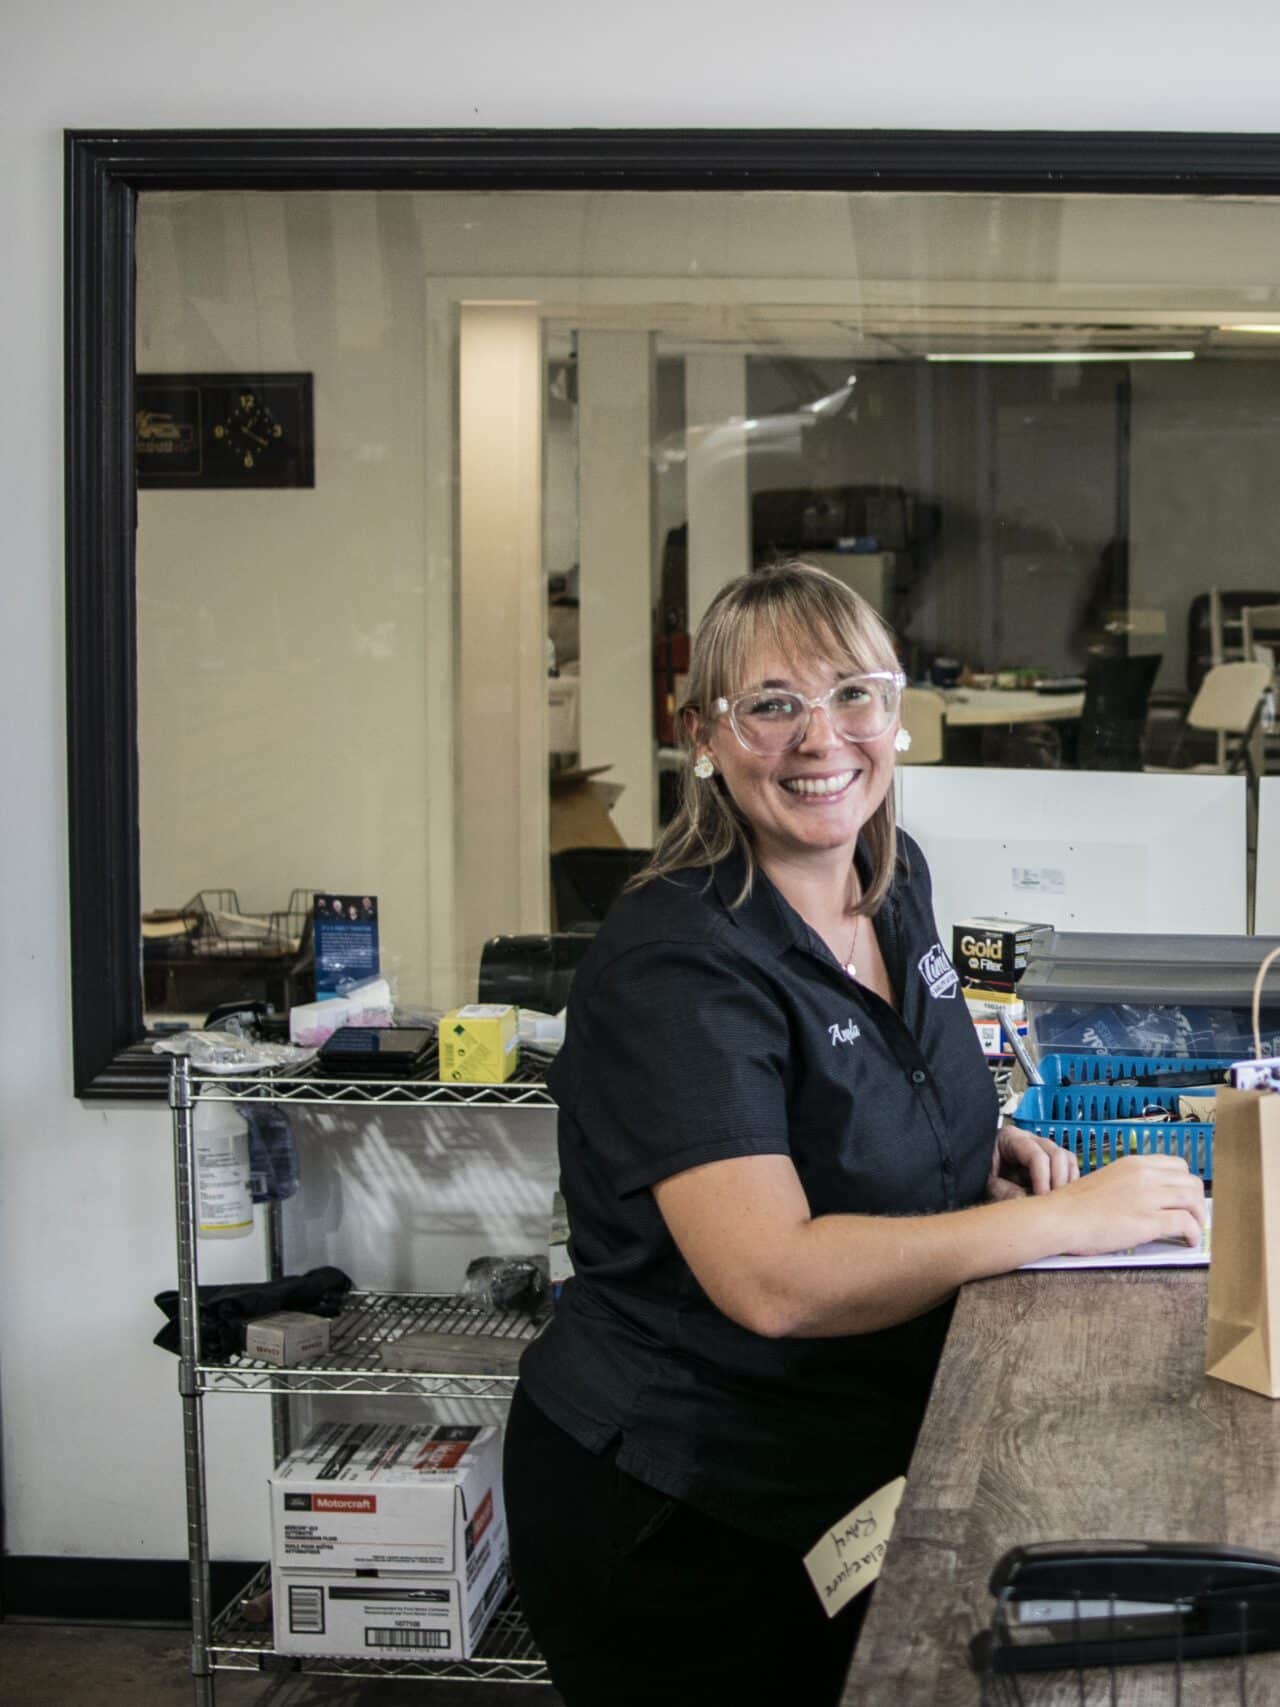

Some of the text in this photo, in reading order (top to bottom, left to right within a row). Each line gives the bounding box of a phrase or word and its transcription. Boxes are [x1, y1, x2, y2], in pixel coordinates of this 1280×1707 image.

[240, 393, 255, 408] 12
[272, 424, 283, 438] 3
[960, 935, 1003, 961] Gold
[979, 958, 1003, 973] Filter
[316, 1498, 372, 1509] Motorcraft
